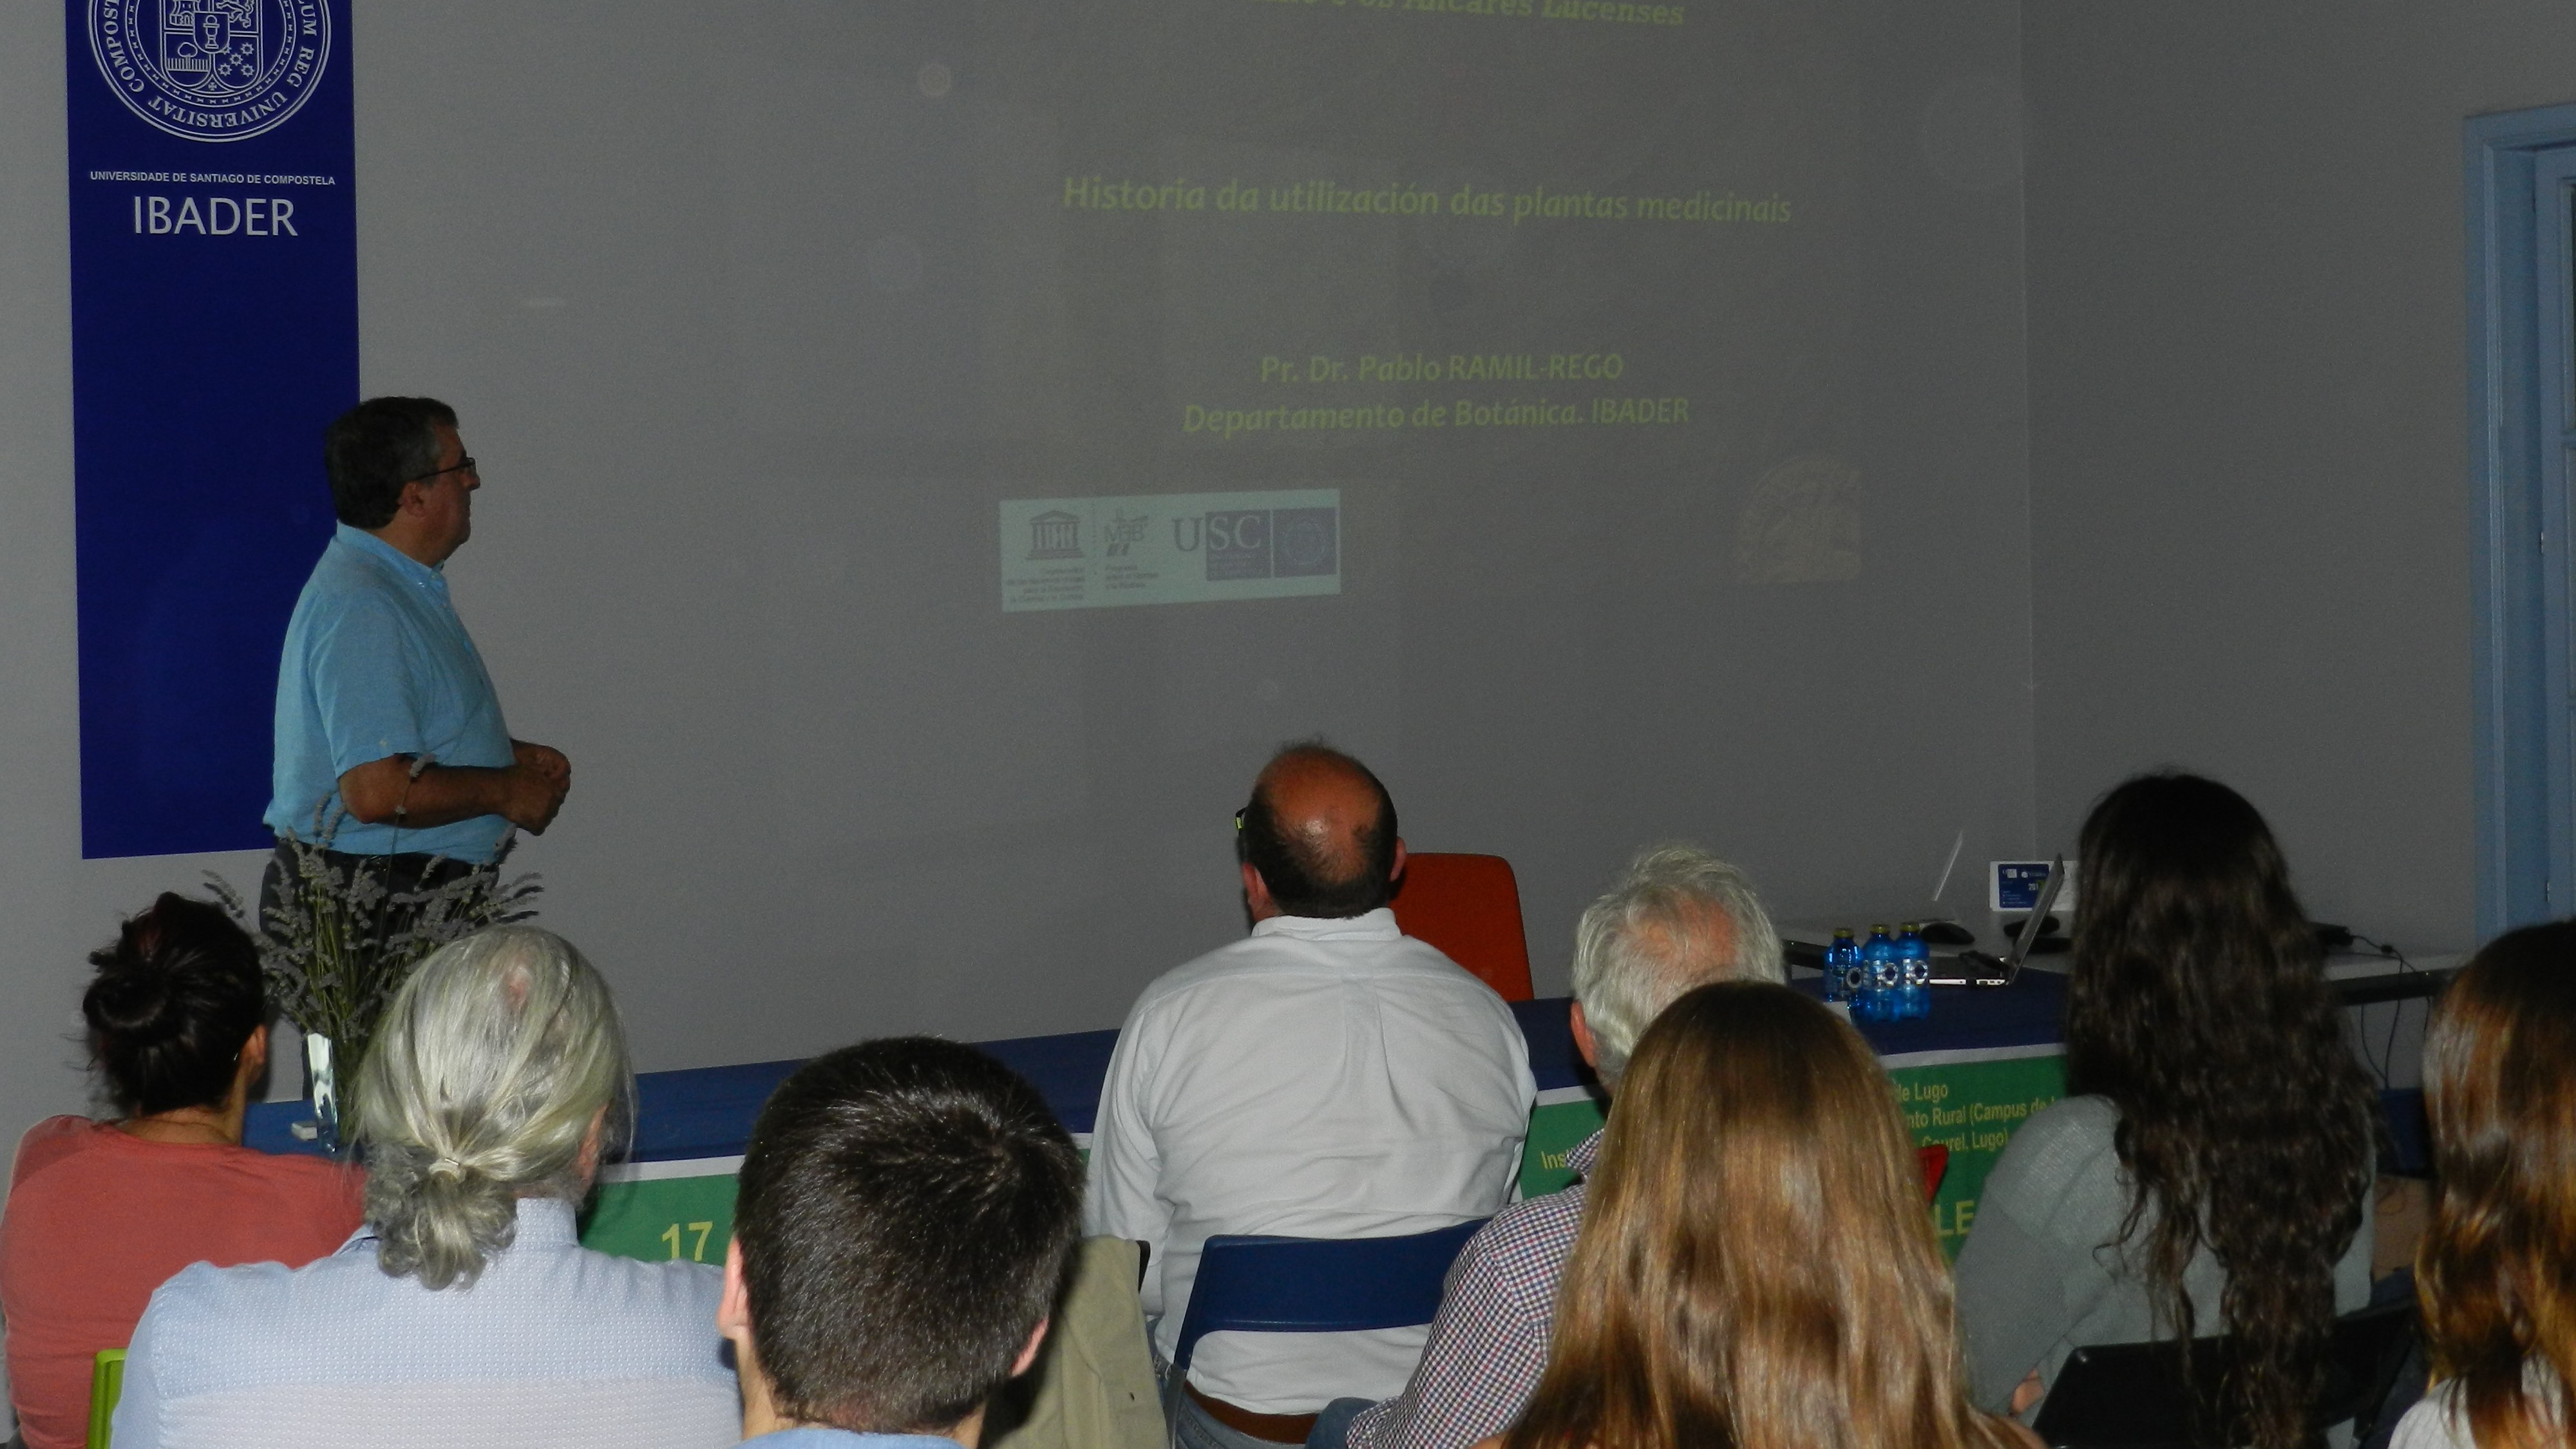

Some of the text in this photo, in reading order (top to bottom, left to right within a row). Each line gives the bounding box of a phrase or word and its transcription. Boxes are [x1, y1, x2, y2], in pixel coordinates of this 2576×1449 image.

[1541, 0, 1685, 25] Lucenses
[286, 46, 316, 88] REG
[148, 91, 289, 128] UNIVERSITAT
[90, 171, 336, 185] UNIVERSIDADE DE SANTIAGO DE COMPOSTELA
[134, 196, 299, 236] IBADER
[1063, 175, 1792, 227] Historia da utilización das plantas medicinais
[1260, 354, 1625, 383] Pr. Dr. Pablo RAMIL-REGO
[1182, 398, 1690, 440] Departamento de Botánica. IBADER
[1171, 514, 1262, 552] USC
[1915, 1083, 1948, 1103] Lugo
[1906, 1112, 1928, 1128] nto
[1933, 1105, 1967, 1126] Rural
[1969, 1101, 2027, 1126] (Campus
[1973, 1127, 2008, 1152] Lugo)
[1540, 1150, 1569, 1169] Ins
[661, 1221, 713, 1262] 17
